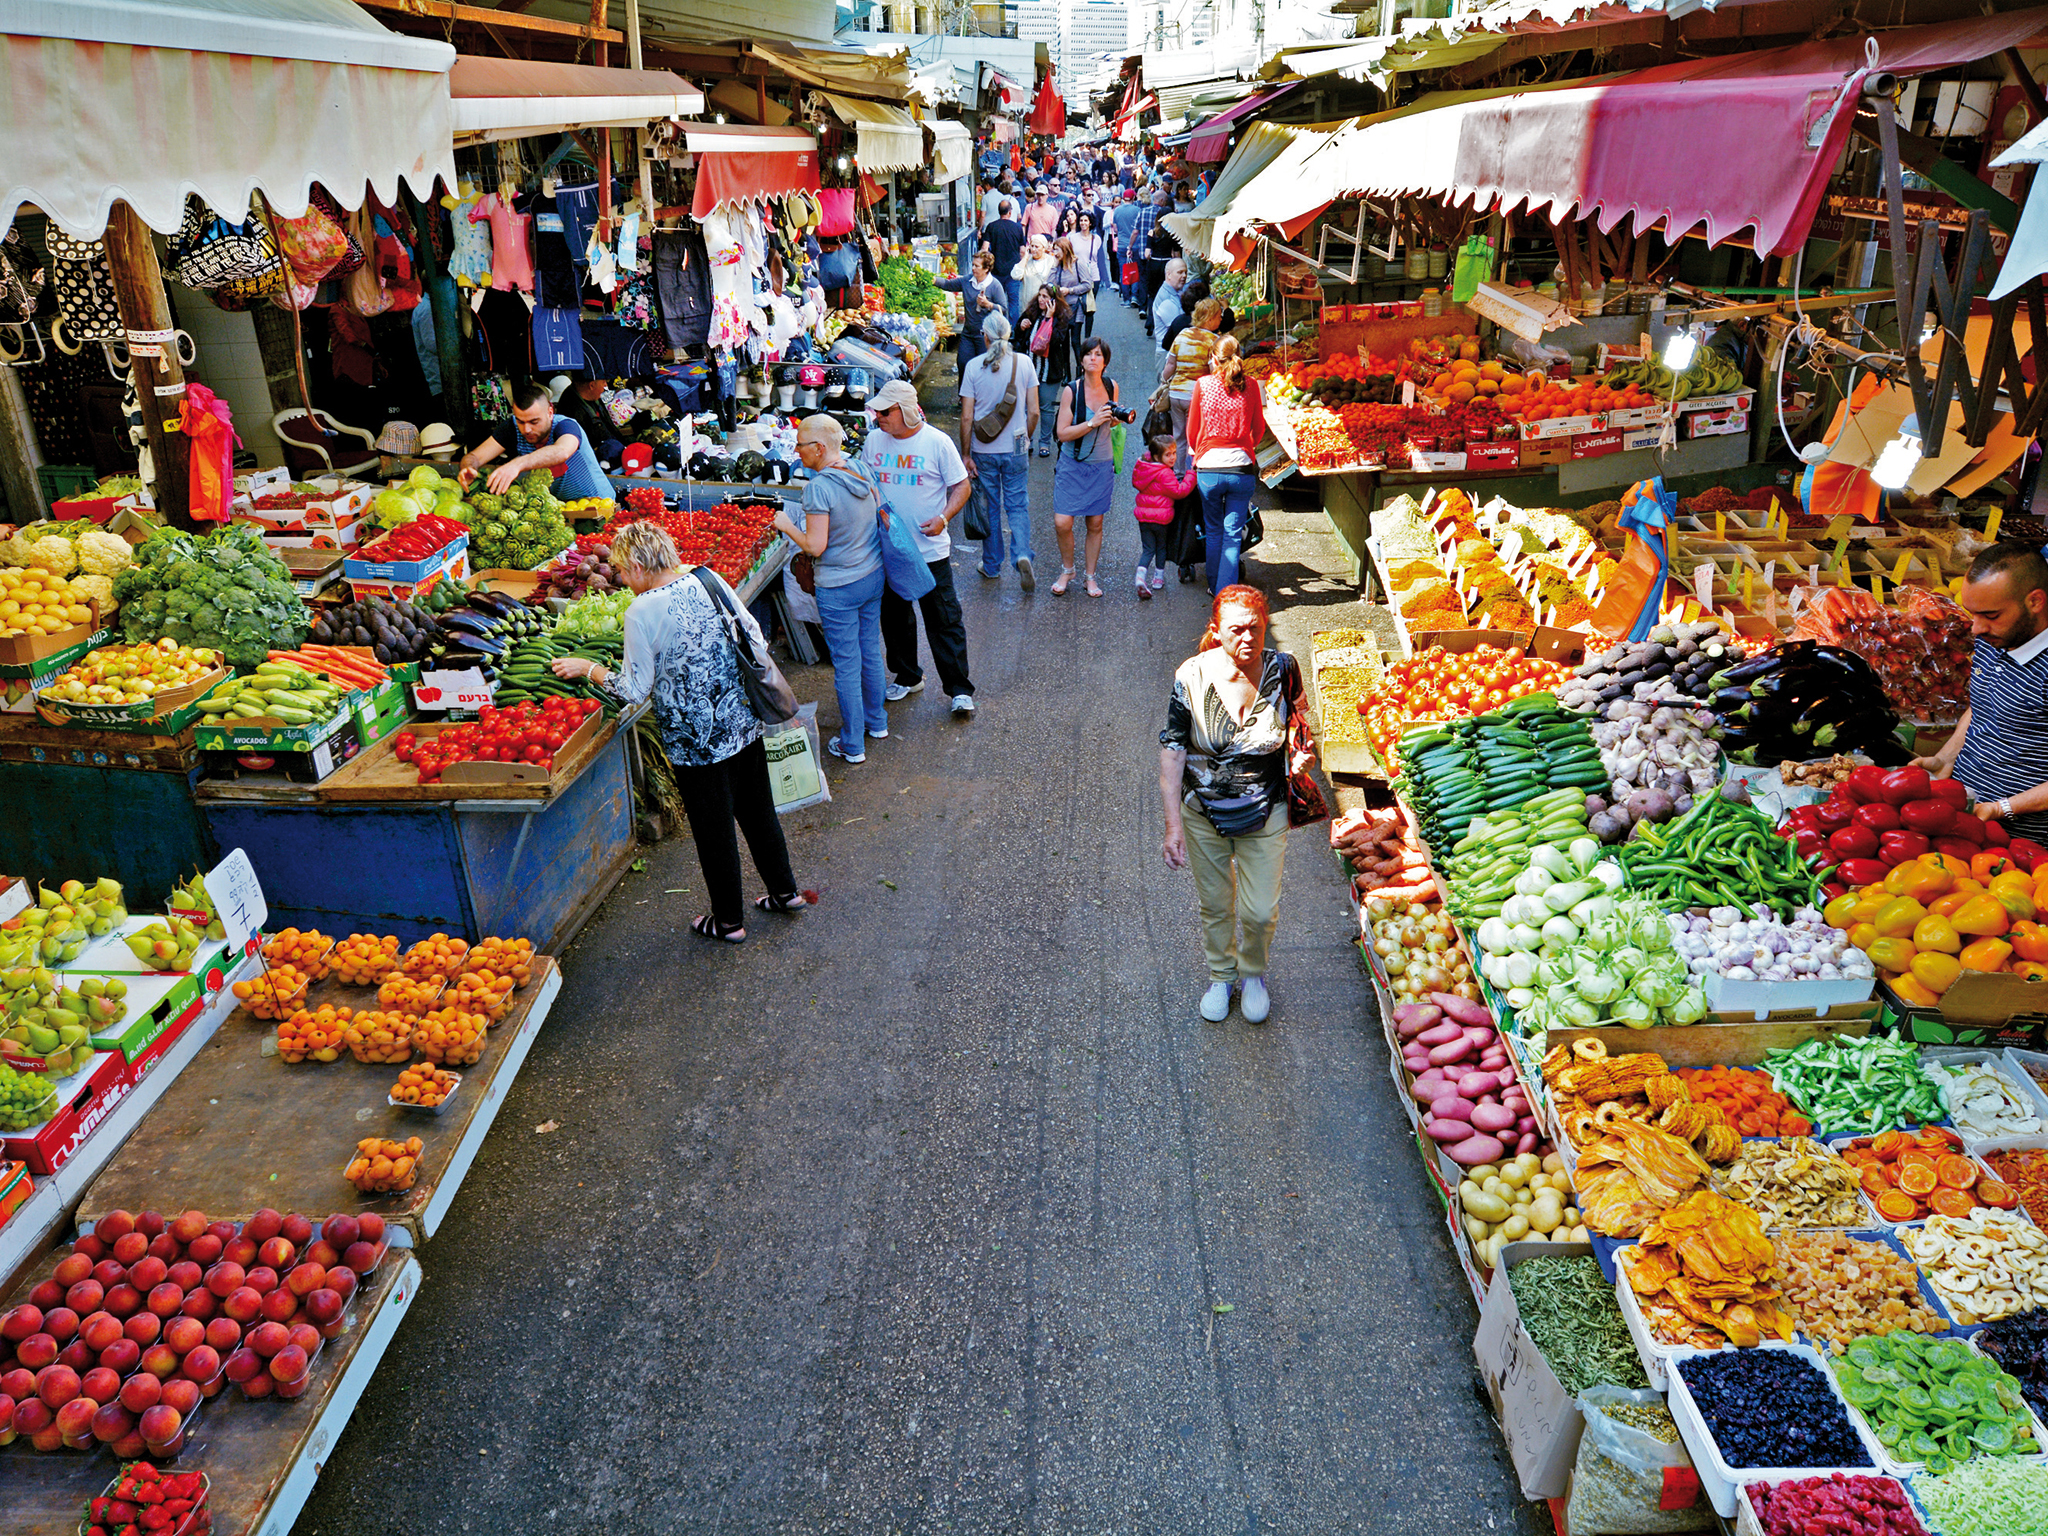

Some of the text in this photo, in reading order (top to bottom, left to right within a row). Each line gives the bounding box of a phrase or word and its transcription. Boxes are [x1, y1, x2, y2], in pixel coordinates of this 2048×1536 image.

[805, 369, 818, 381] NY
[87, 630, 109, 649] בננות
[458, 694, 490, 703] ברעם
[233, 737, 268, 745] AVOCADOS
[1772, 1012, 1813, 1021] AVOCADOS
